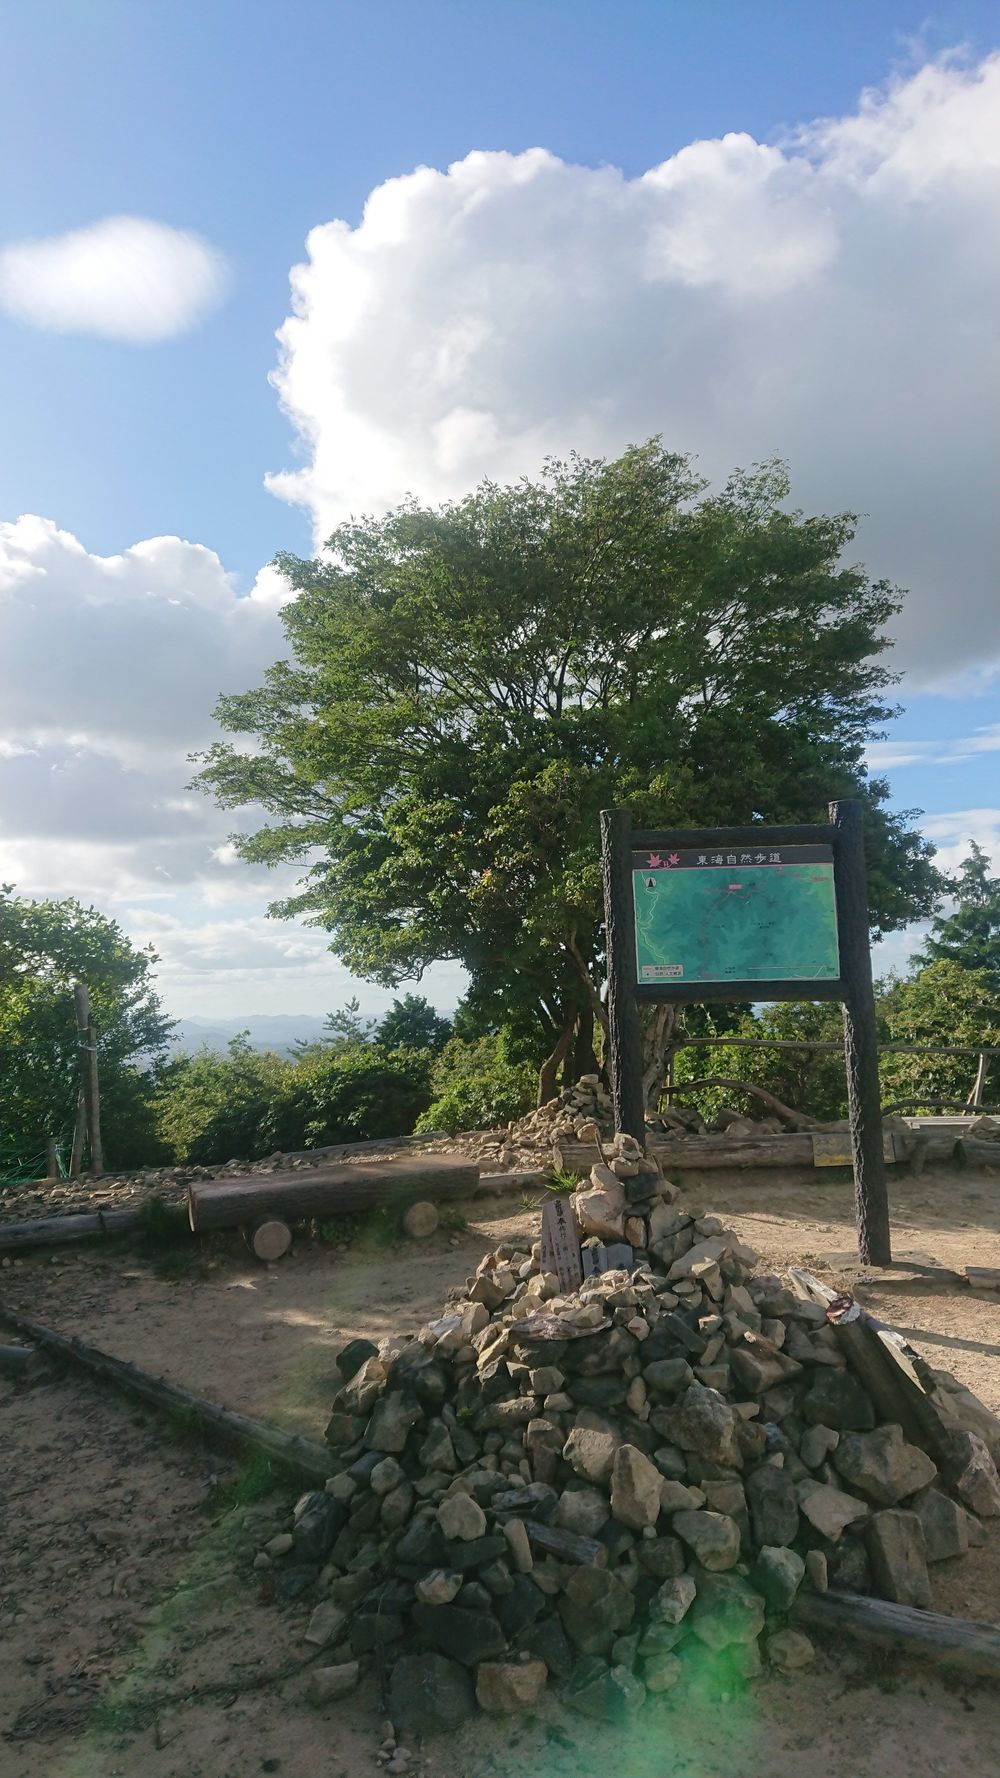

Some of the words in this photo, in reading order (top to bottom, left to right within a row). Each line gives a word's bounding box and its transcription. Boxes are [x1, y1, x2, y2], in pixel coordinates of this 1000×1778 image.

[696, 852, 782, 865] 東海自然歩道
